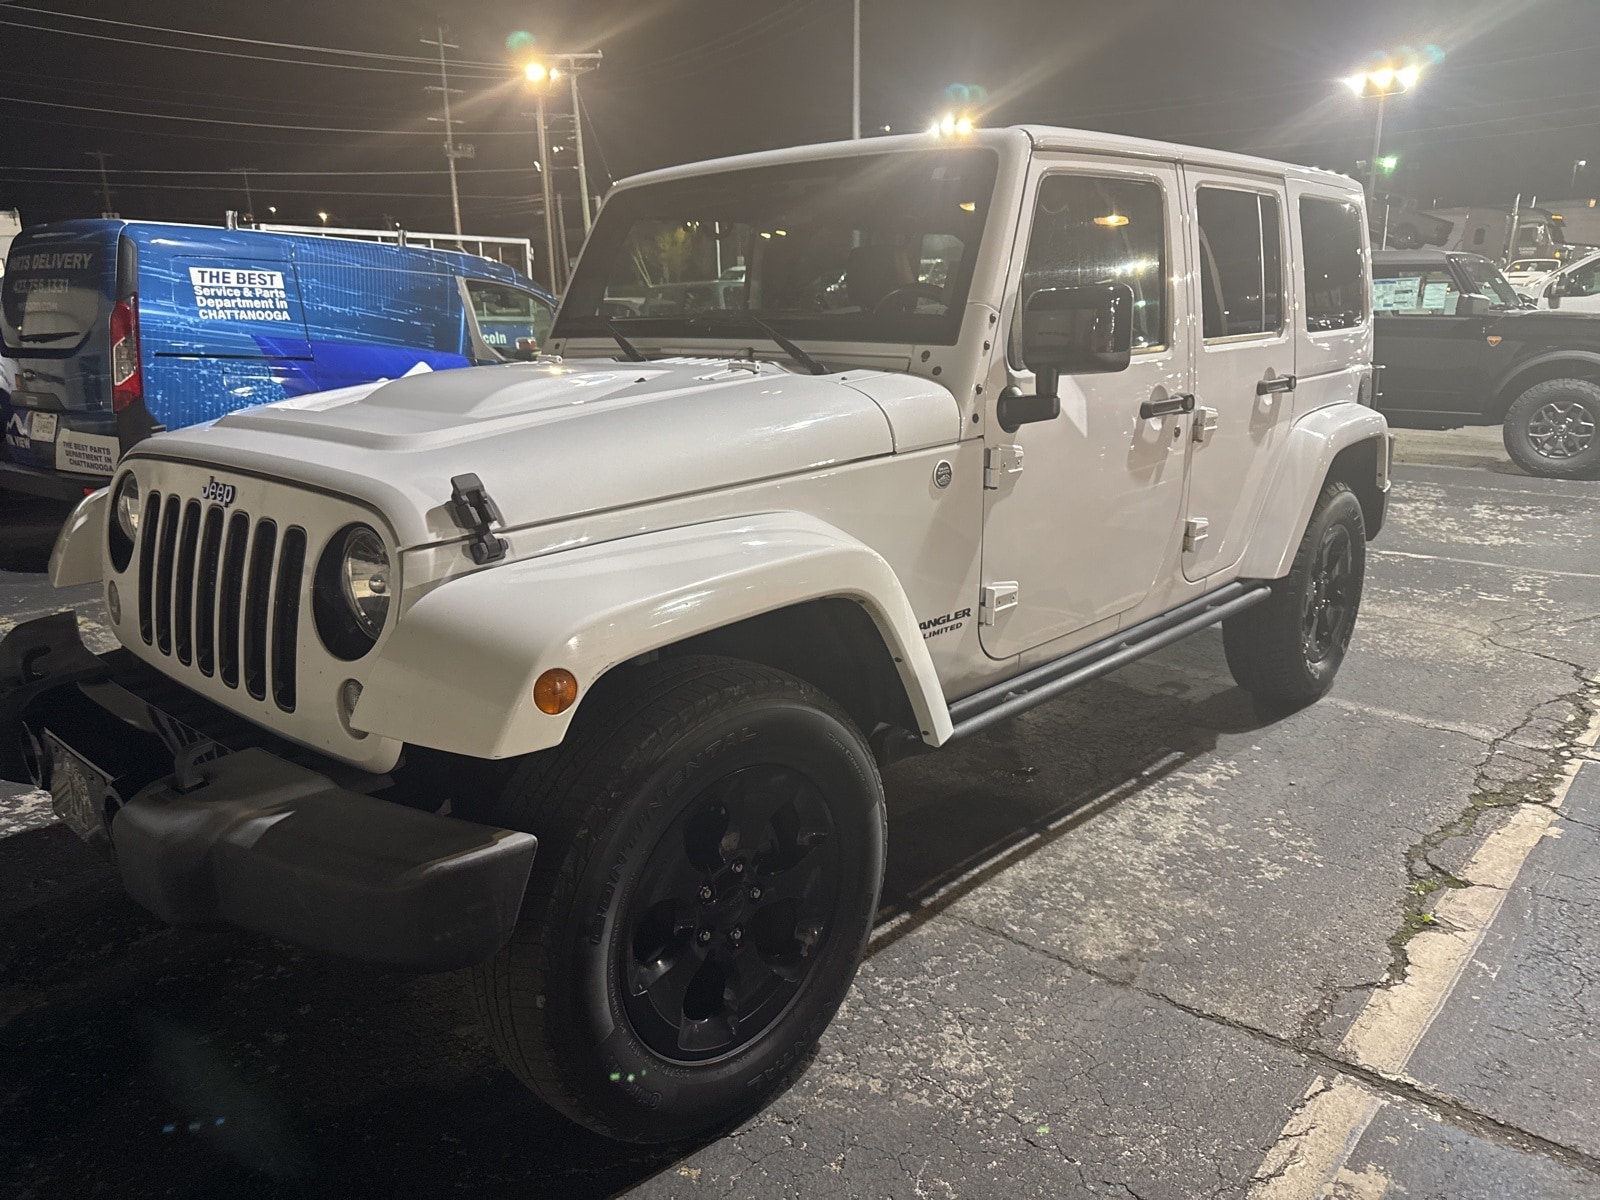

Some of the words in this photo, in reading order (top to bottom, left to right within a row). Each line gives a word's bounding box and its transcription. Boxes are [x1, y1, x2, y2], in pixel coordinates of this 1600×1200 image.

[32, 253, 93, 269] DELIVERY
[197, 269, 231, 284] THE
[236, 271, 276, 286] BEST
[193, 285, 240, 297] Service
[243, 287, 253, 298] &
[255, 287, 286, 299] Parts
[195, 296, 274, 310] Department
[275, 298, 288, 309] in
[199, 309, 291, 321] CHATTANOOGA
[63, 441, 73, 449] THE
[74, 443, 88, 452] BEST
[89, 445, 111, 456] PARTS
[65, 449, 102, 462] DEPARTMENT
[104, 455, 113, 464] IN
[69, 458, 115, 472] CHATTANOOGA
[201, 475, 237, 508] Jeep
[919, 607, 971, 631] ANGLER
[923, 622, 963, 640] LIMITED
